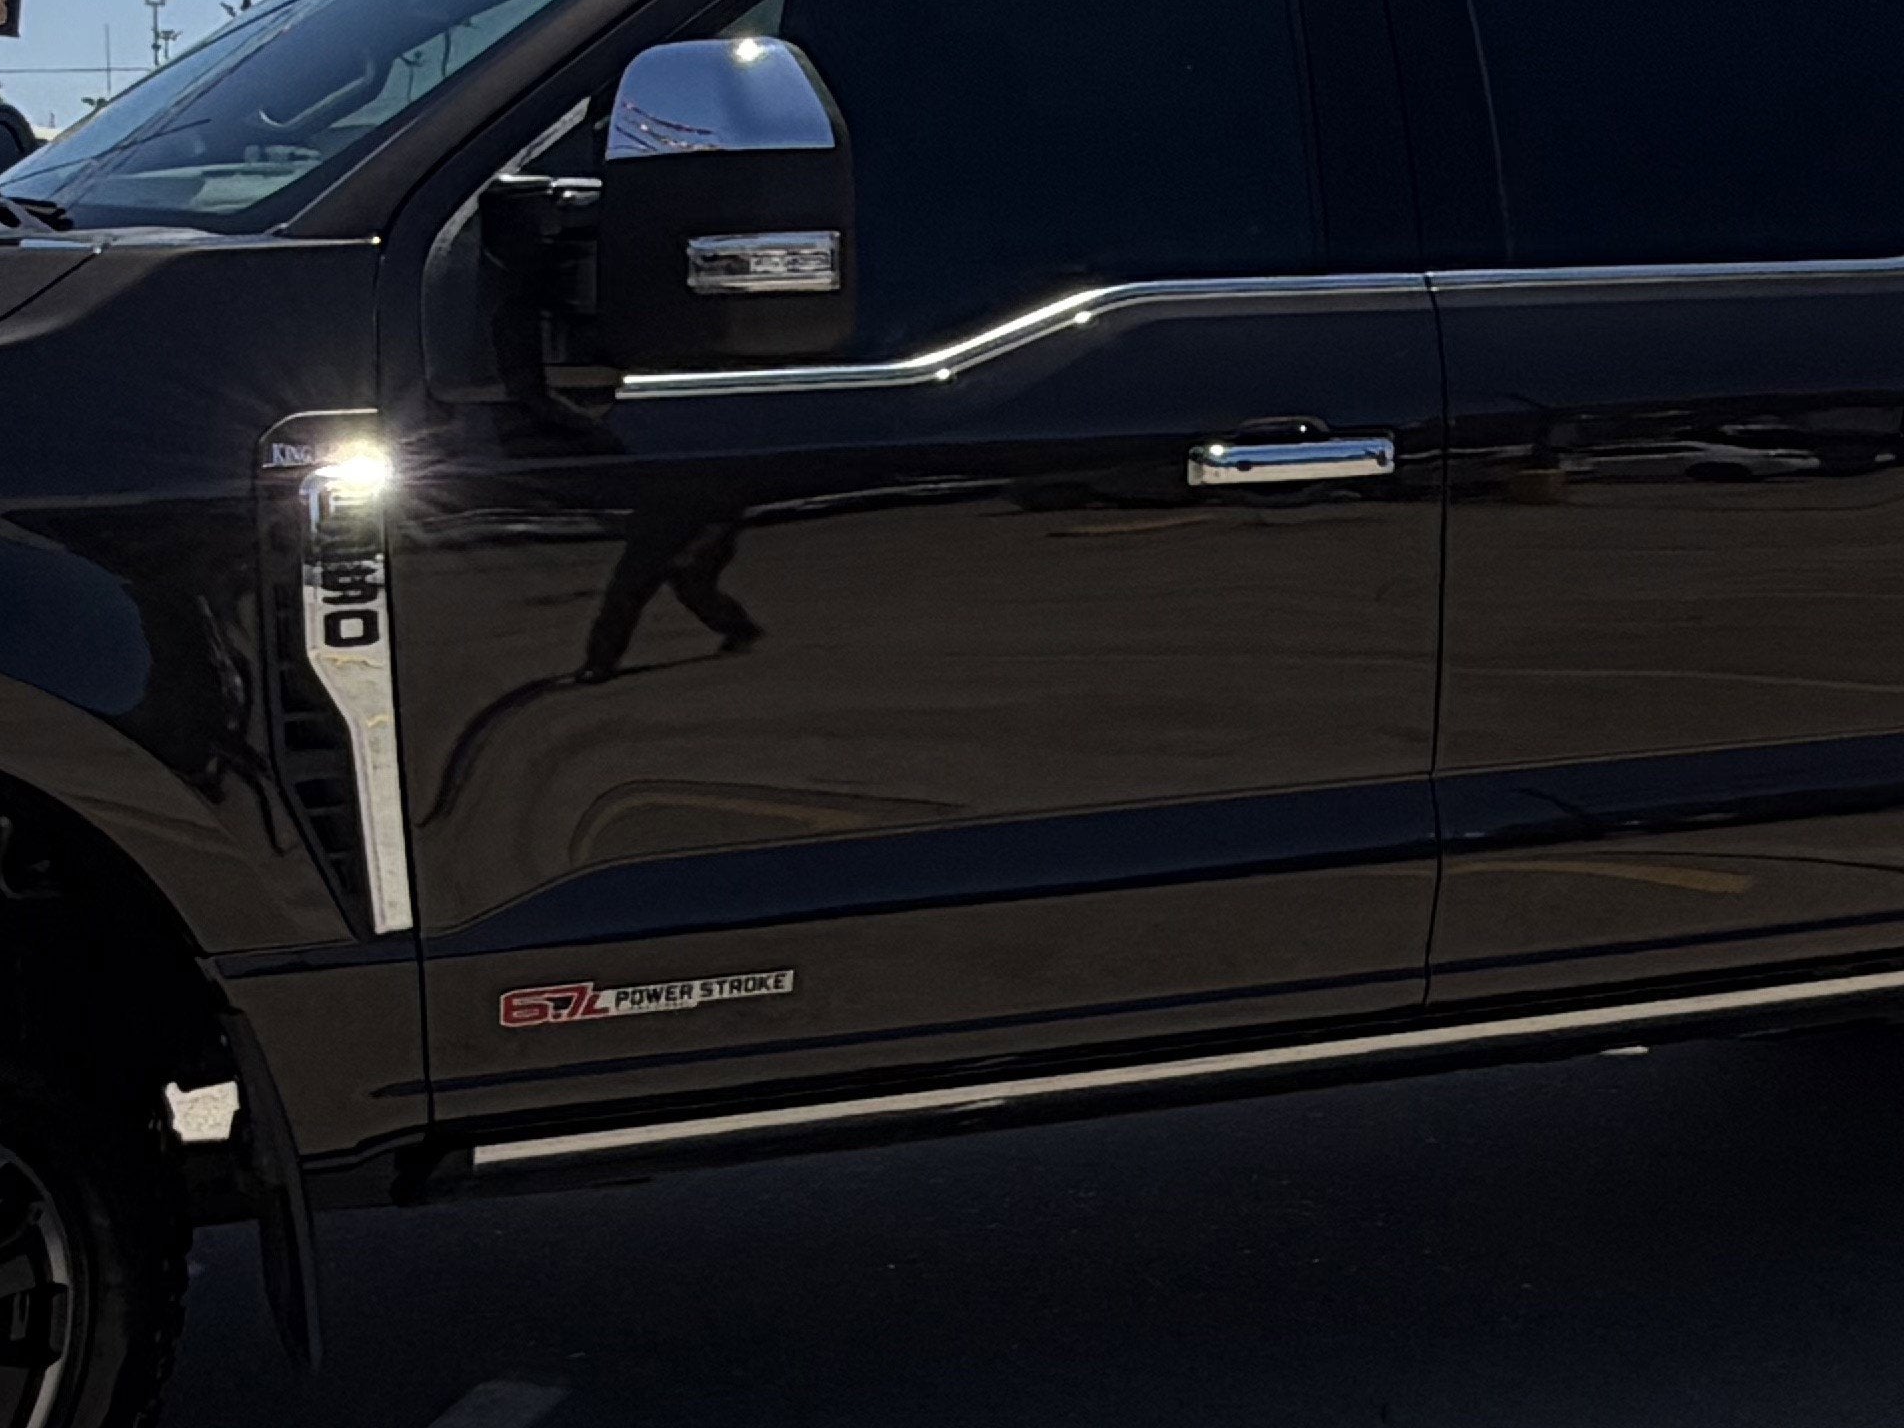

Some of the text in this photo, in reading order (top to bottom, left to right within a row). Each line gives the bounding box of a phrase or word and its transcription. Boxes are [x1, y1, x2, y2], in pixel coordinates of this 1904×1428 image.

[501, 973, 787, 1027] 6.7L POWER STROKE
